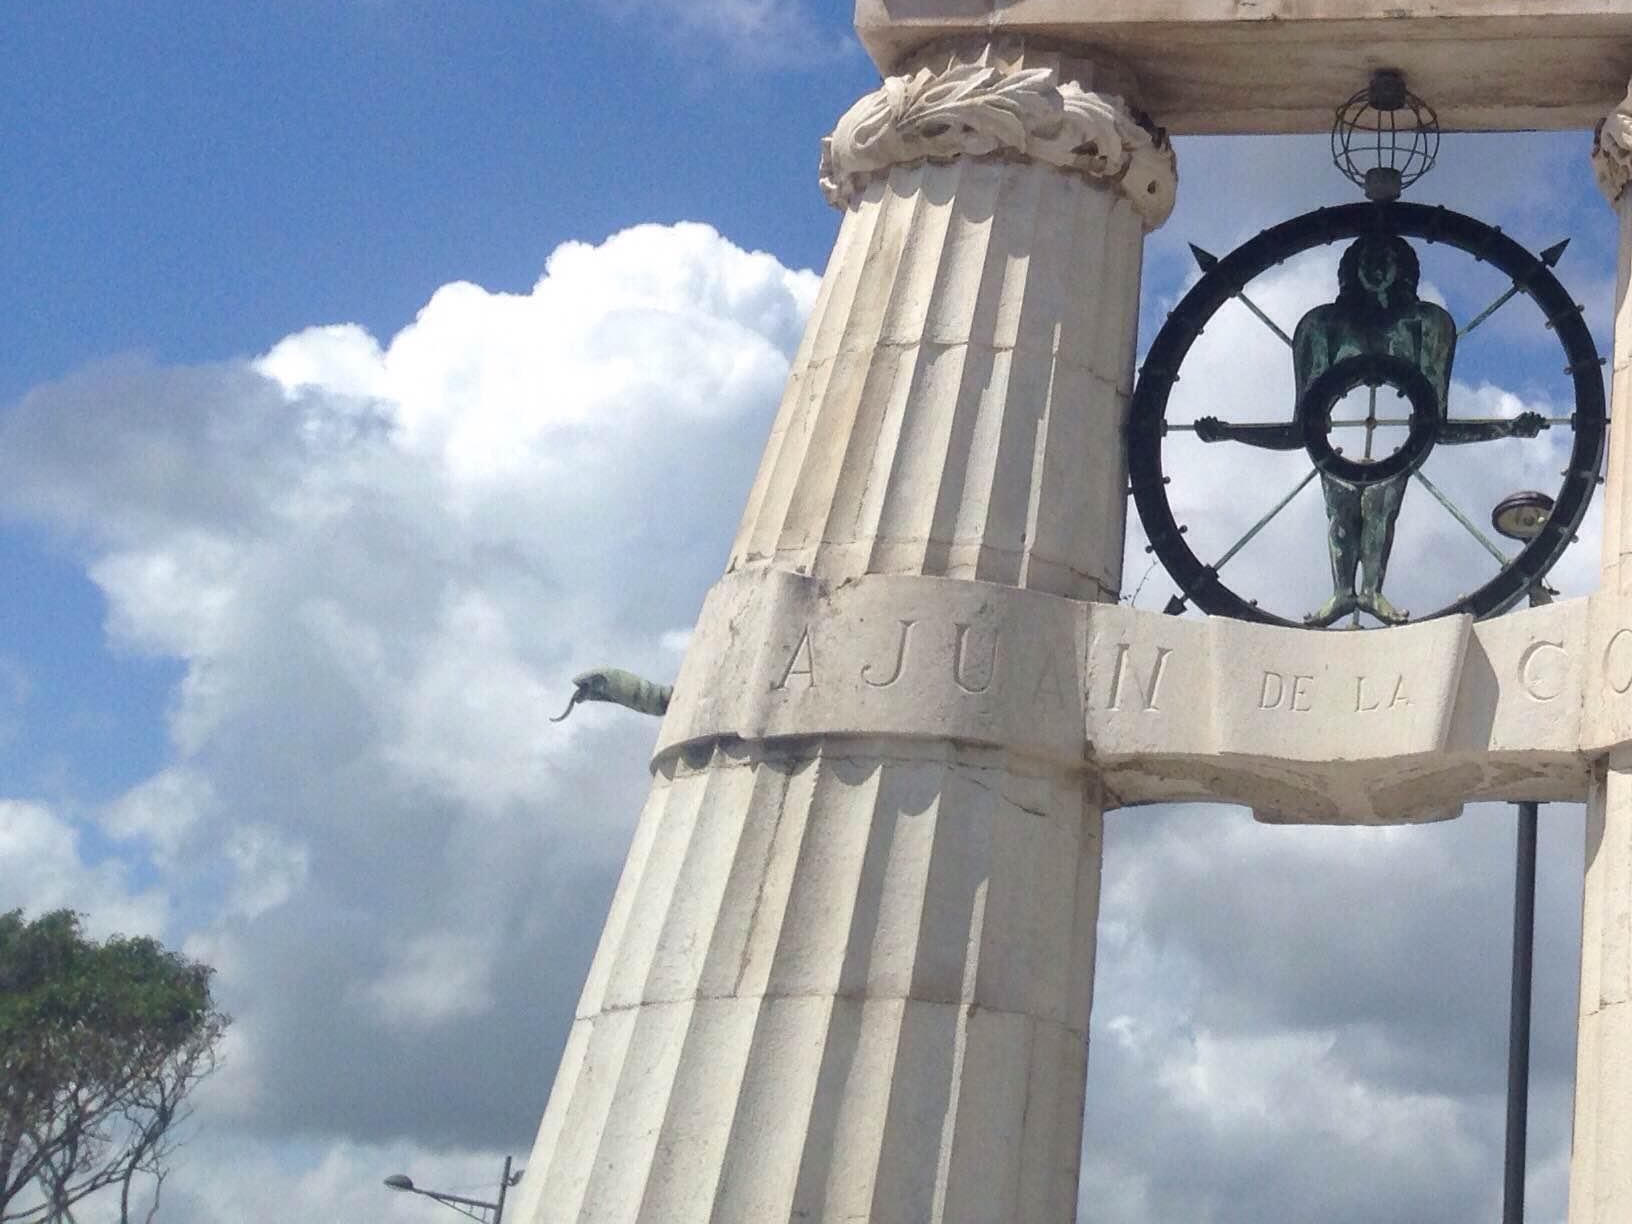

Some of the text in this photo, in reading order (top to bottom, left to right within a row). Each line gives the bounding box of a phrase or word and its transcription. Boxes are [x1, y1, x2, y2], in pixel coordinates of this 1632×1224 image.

[771, 623, 819, 692] A
[860, 619, 1174, 713] JUAN
[1258, 669, 1312, 713] DE
[1353, 672, 1414, 713] LA
